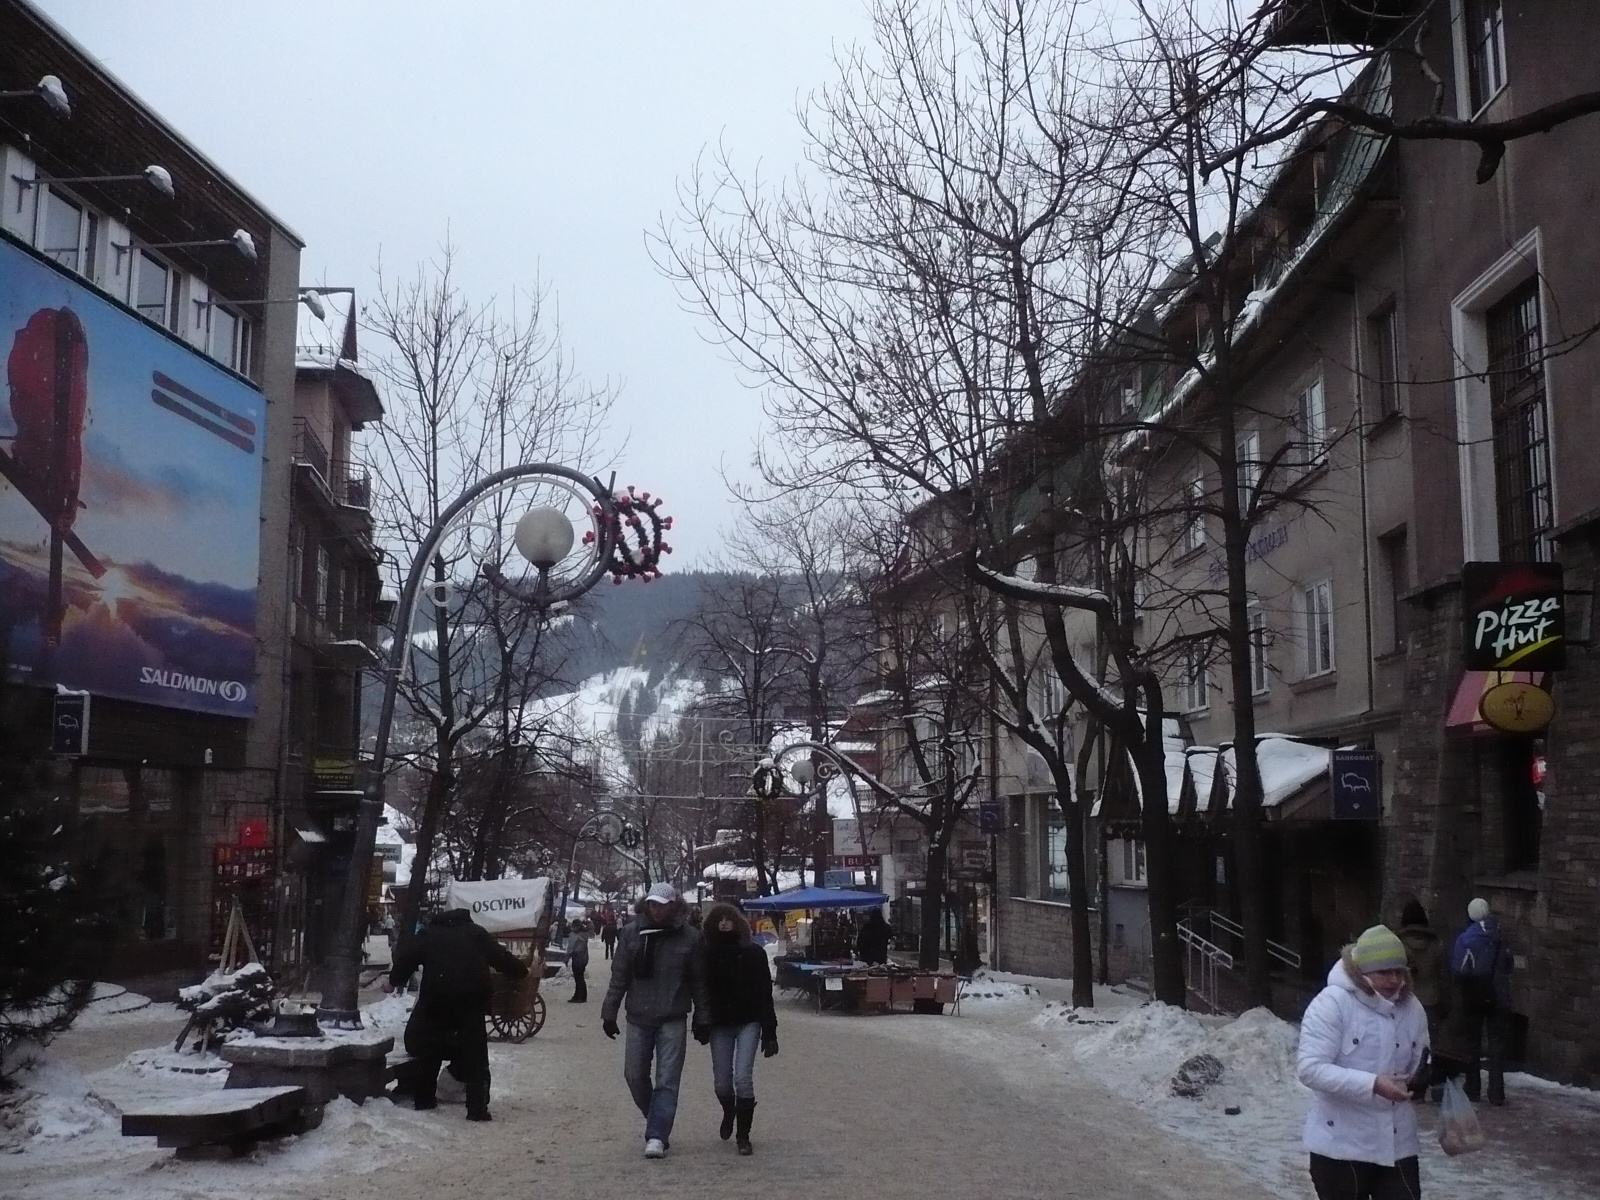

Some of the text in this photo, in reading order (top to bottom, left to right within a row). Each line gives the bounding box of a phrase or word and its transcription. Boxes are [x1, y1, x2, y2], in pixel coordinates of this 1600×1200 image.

[1474, 595, 1561, 650] Pizza
[1490, 617, 1555, 659] Hut
[139, 666, 218, 695] SALOMON
[847, 857, 876, 866] BUY
[472, 897, 526, 914] OSCYPKI
